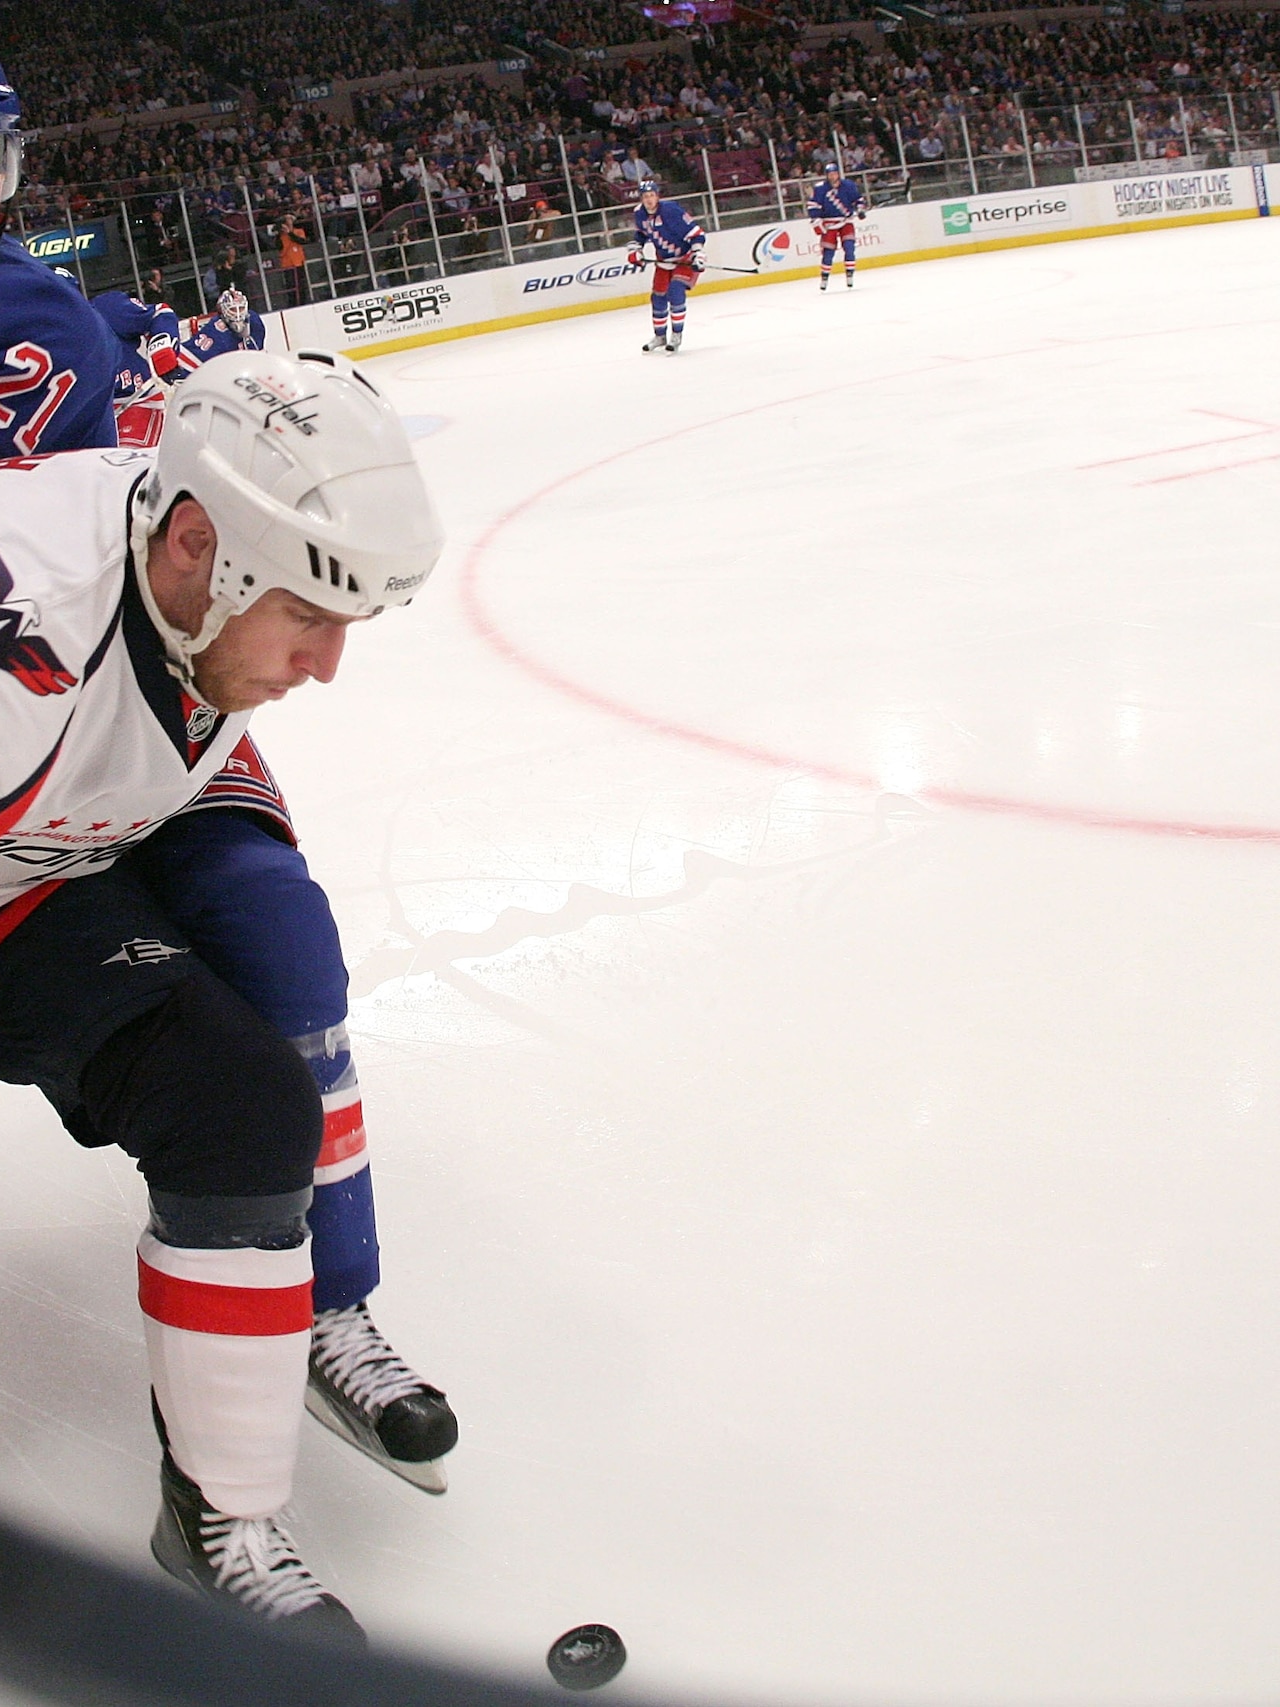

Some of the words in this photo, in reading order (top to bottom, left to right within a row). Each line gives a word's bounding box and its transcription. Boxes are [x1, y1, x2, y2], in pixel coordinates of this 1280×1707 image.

[305, 87, 329, 98] 103
[1113, 180, 1165, 202] HOCKEY
[1166, 177, 1203, 199] NIGHT
[1206, 174, 1232, 193] LIVE
[944, 199, 1067, 227] enterprise
[1116, 200, 1163, 217] SATURDAY
[1165, 197, 1197, 212] NIGHTS
[1199, 194, 1212, 208] ON
[29, 233, 95, 258] LIGHT
[523, 274, 573, 293] BUD
[334, 296, 380, 313] SELECT
[392, 285, 445, 300] SECTOR
